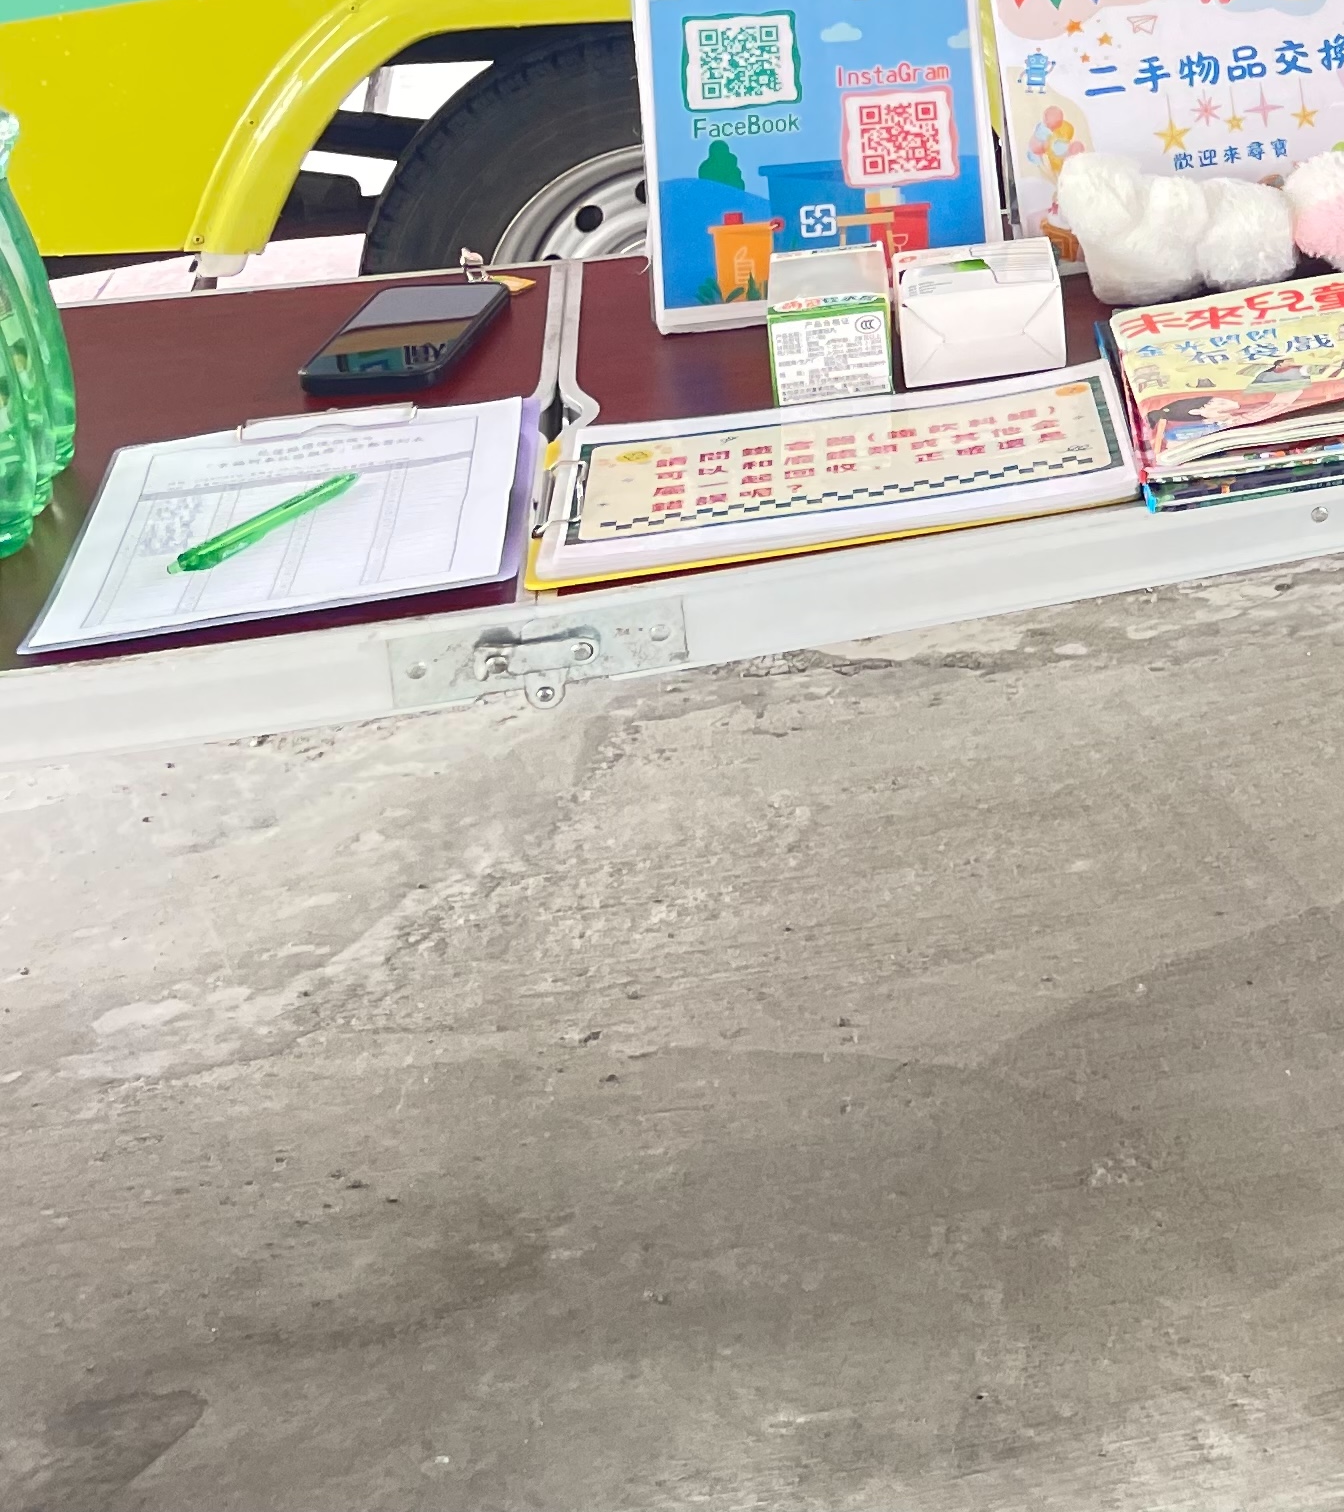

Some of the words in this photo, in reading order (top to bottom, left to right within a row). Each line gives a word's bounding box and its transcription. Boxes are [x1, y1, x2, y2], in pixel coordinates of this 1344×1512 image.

[836, 63, 950, 87] InstaGram
[693, 114, 801, 139] FaceBook
[1173, 138, 1289, 171] 歡迎來尋寶
